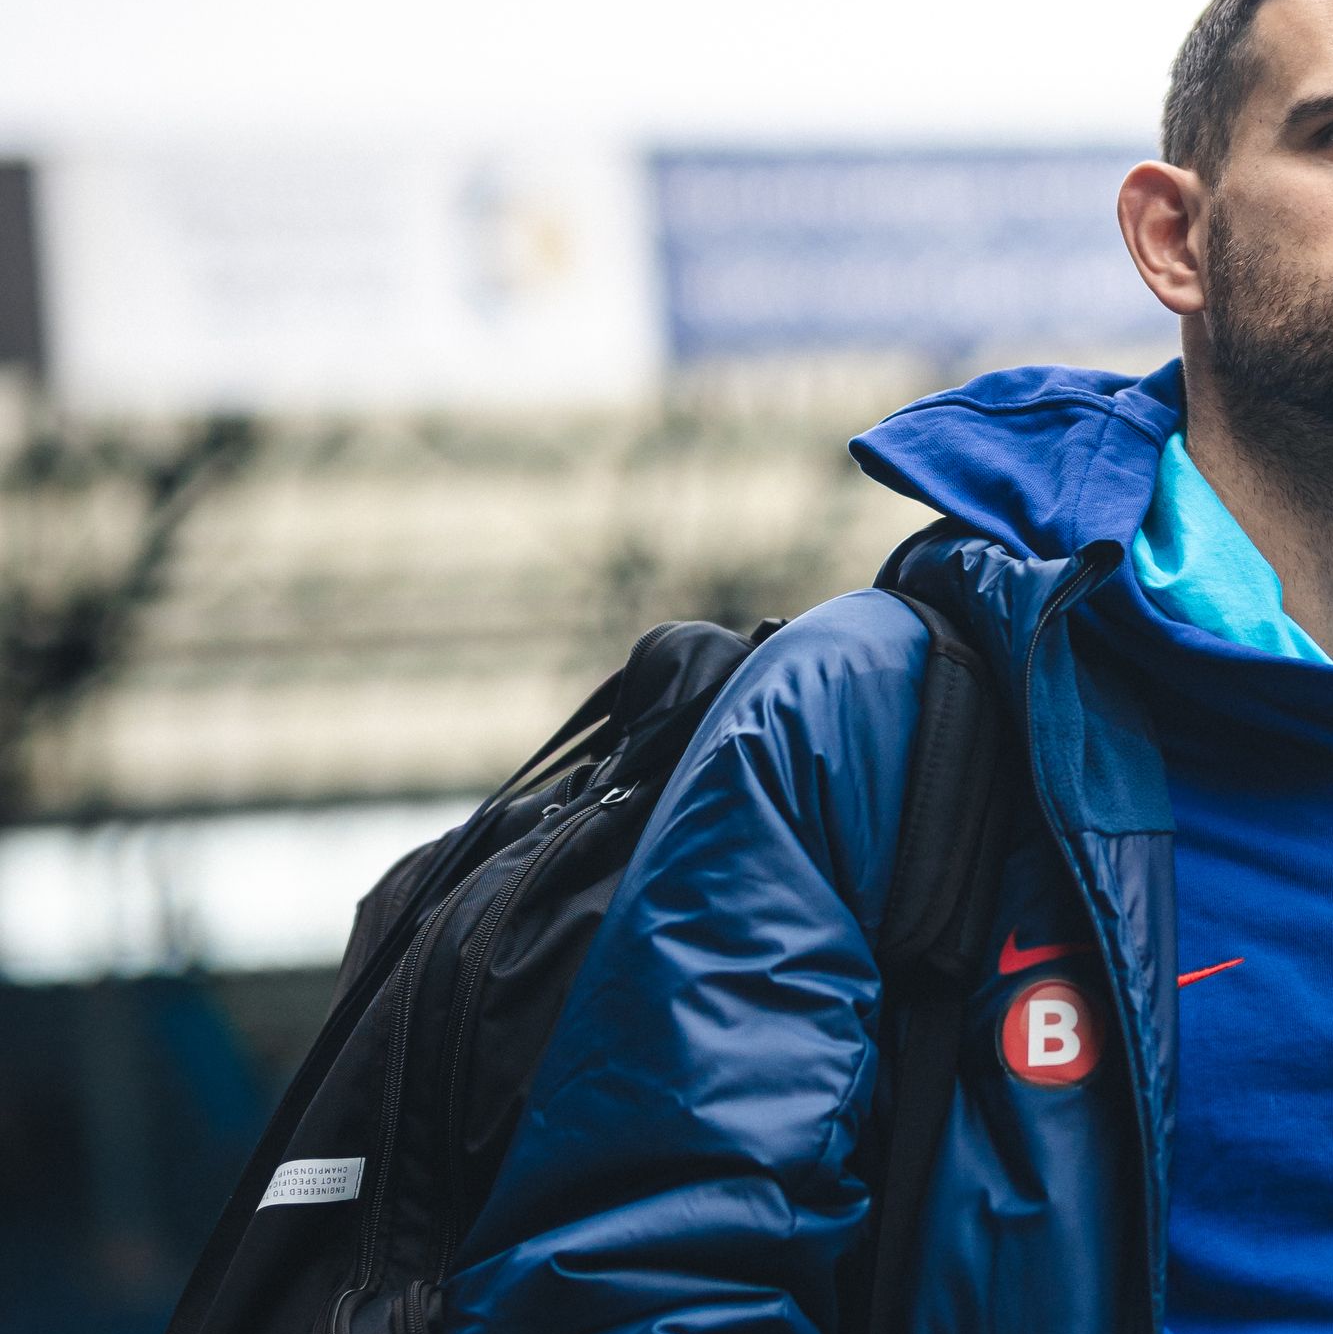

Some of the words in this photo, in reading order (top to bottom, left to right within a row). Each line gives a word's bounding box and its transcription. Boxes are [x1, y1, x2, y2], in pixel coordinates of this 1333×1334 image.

[1027, 1000, 1081, 1067] B
[277, 1166, 348, 1178] CHAMPIONSHIP
[321, 1176, 347, 1185] EXACT
[272, 1189, 285, 1198] TO
[289, 1186, 346, 1196] ENGINEERED
